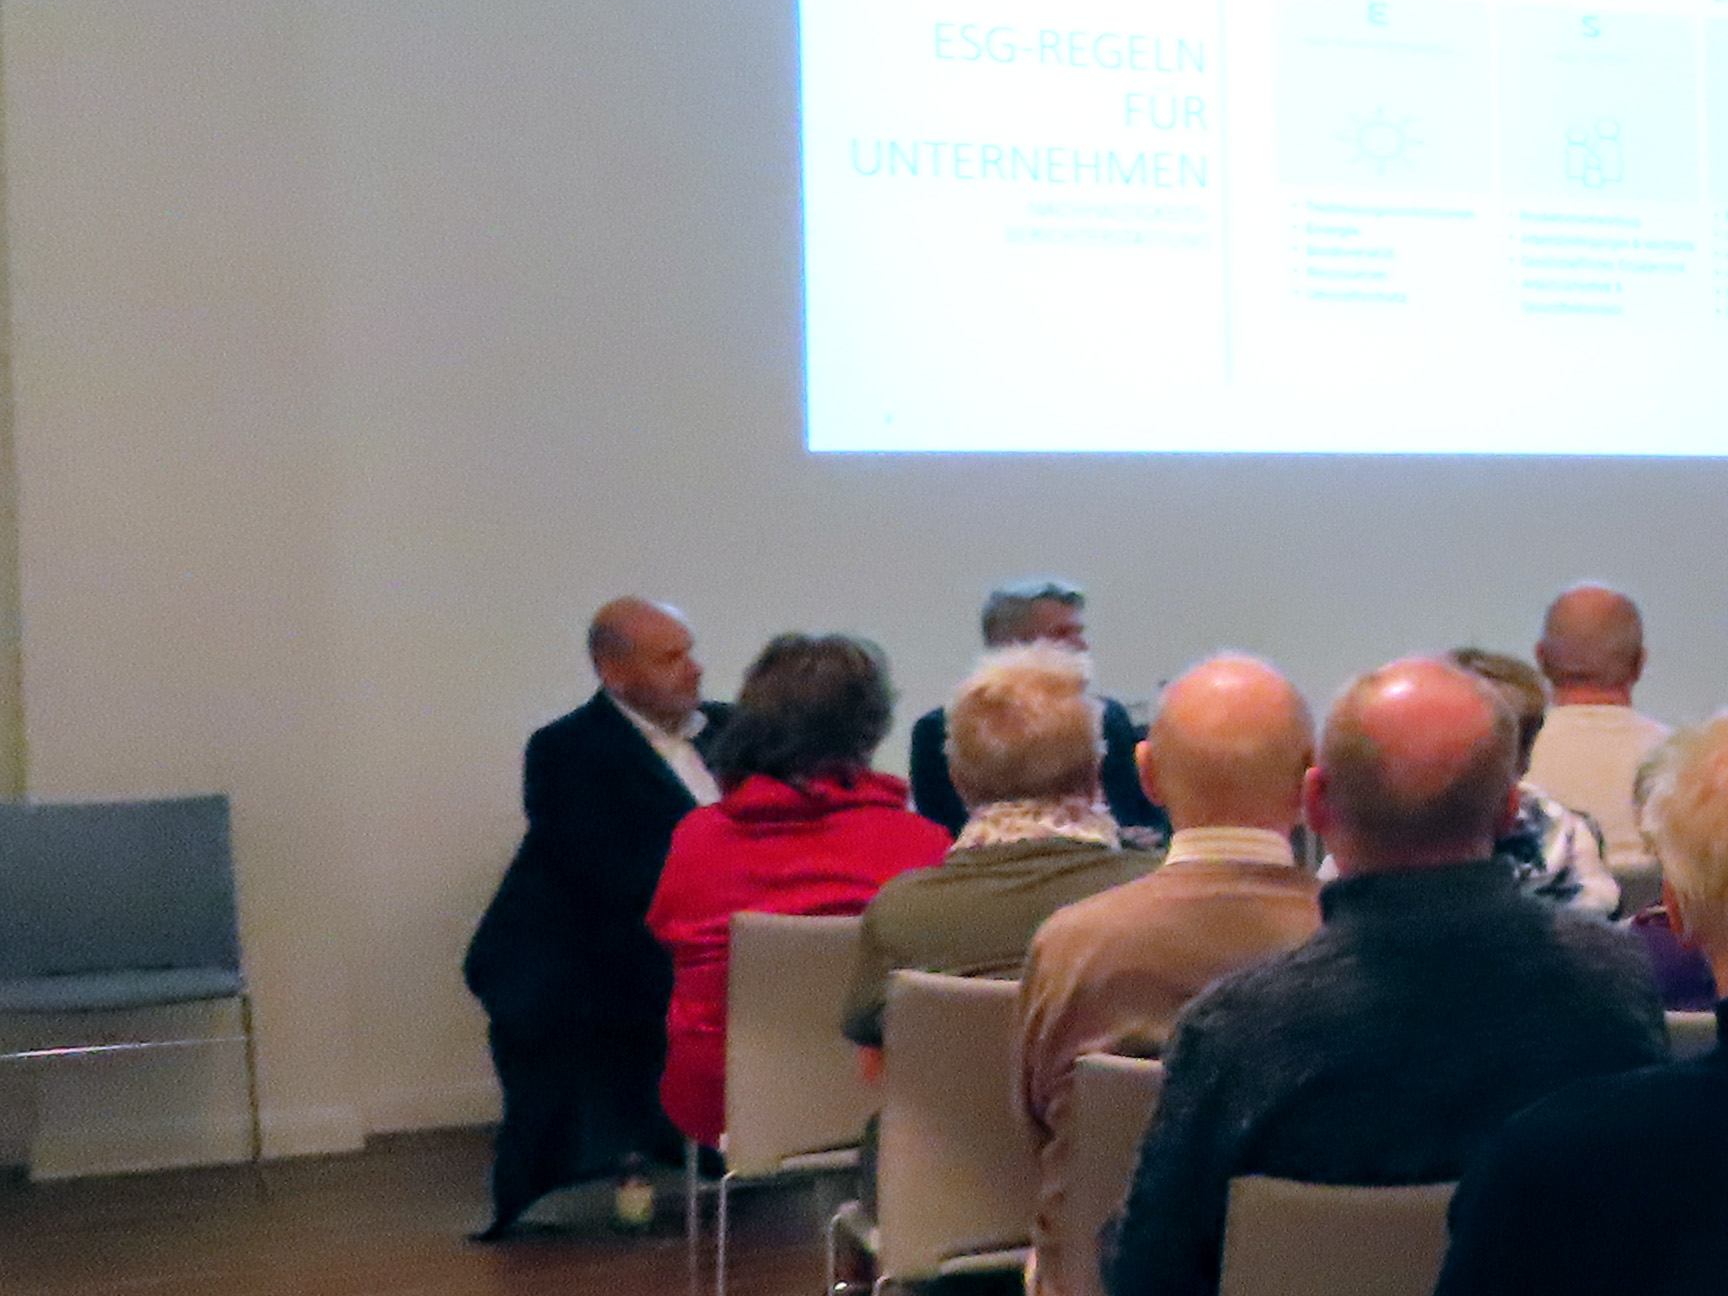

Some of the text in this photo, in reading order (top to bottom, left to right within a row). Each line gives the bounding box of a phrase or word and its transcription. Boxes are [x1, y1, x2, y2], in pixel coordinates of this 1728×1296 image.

[1366, 0, 1389, 27] E
[1580, 13, 1603, 39] S
[932, 20, 1206, 74] ESG-REGELN
[1123, 86, 1208, 132] FÜR
[850, 137, 1208, 190] UNTERNEHMEN
